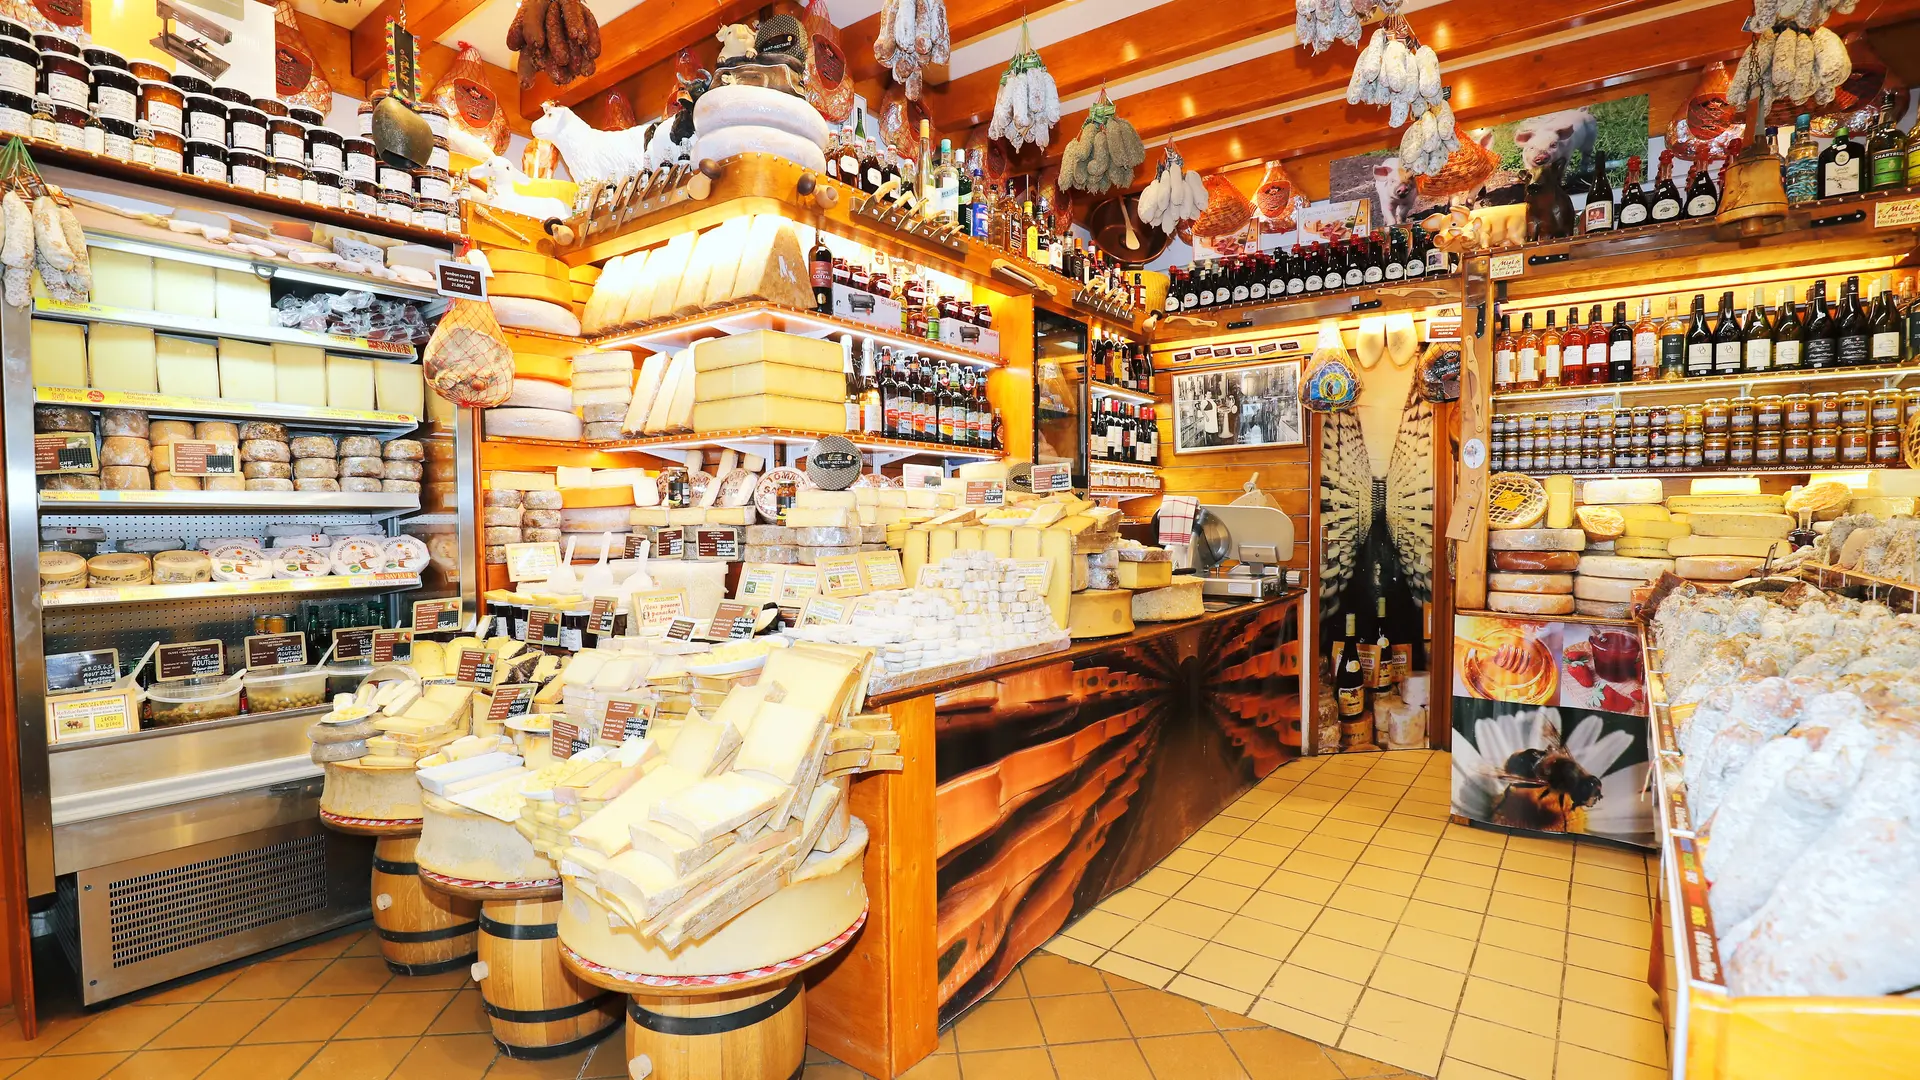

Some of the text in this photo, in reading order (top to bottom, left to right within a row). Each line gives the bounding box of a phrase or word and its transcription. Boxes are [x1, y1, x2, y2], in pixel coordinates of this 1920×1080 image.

[1886, 204, 1911, 214] Miel
[1498, 259, 1515, 268] Miel
[445, 270, 460, 278] Jambon
[384, 571, 418, 580] SAVEURS
[660, 602, 681, 611] pouvons
[651, 609, 677, 619] panacher
